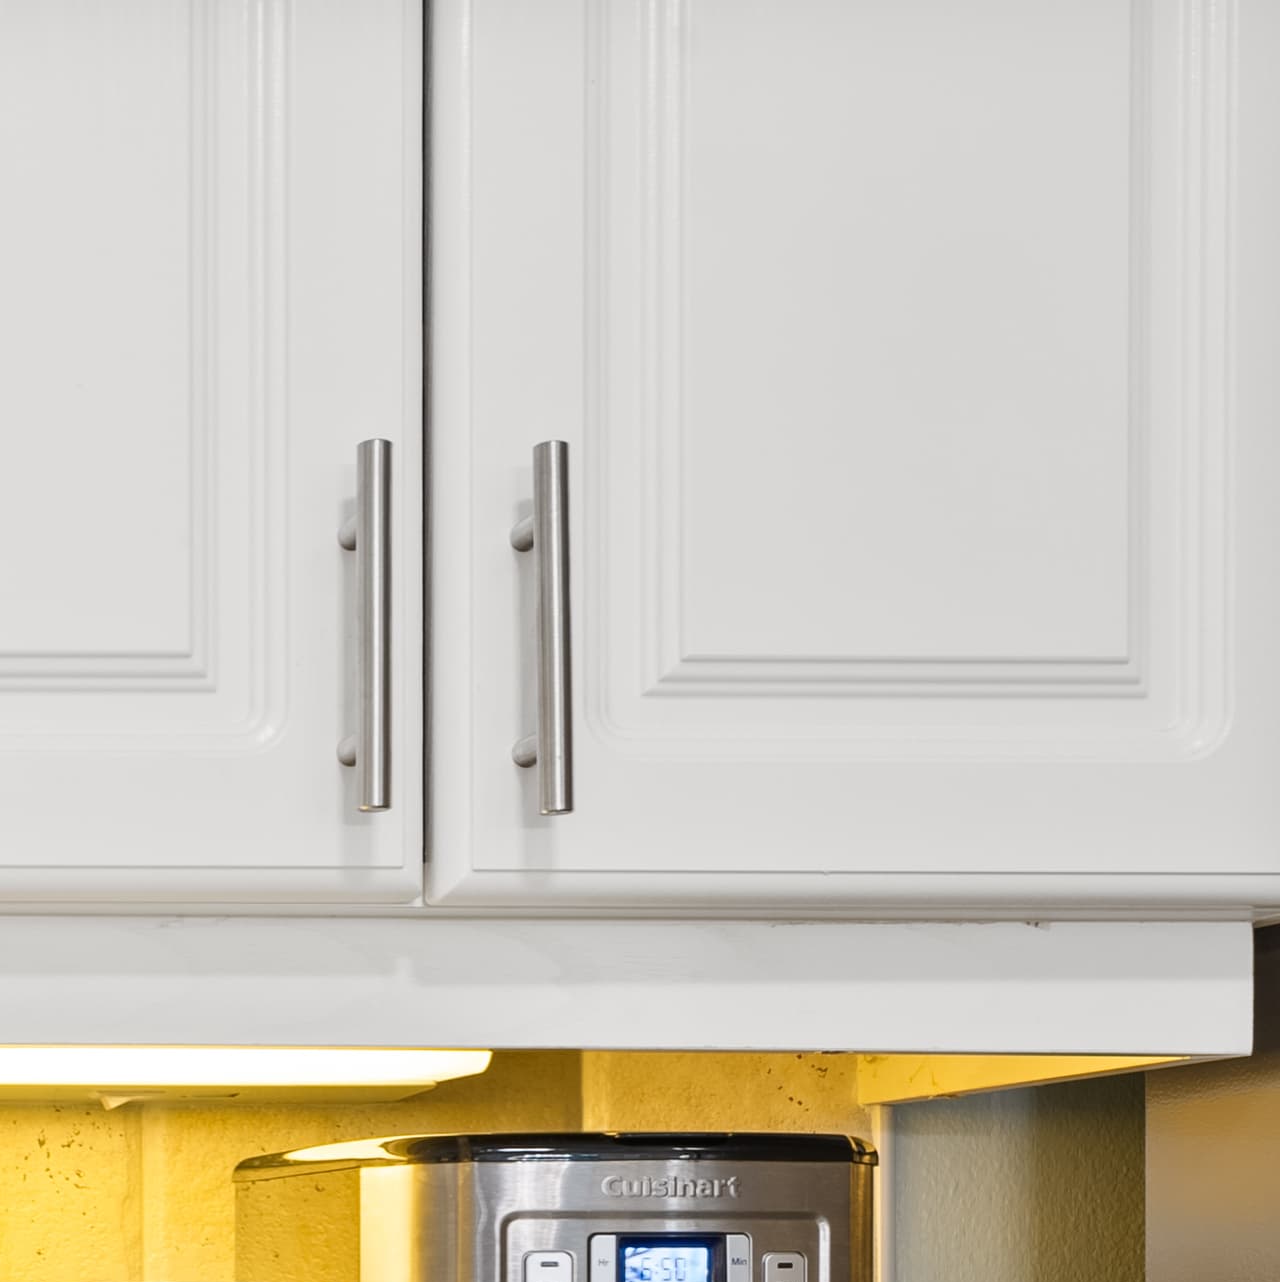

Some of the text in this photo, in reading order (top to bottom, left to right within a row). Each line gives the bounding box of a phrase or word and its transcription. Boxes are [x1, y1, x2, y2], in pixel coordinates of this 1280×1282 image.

[600, 1175, 740, 1199] Cuisinart
[598, 1258, 609, 1267] Hr
[731, 1257, 747, 1266] Min
